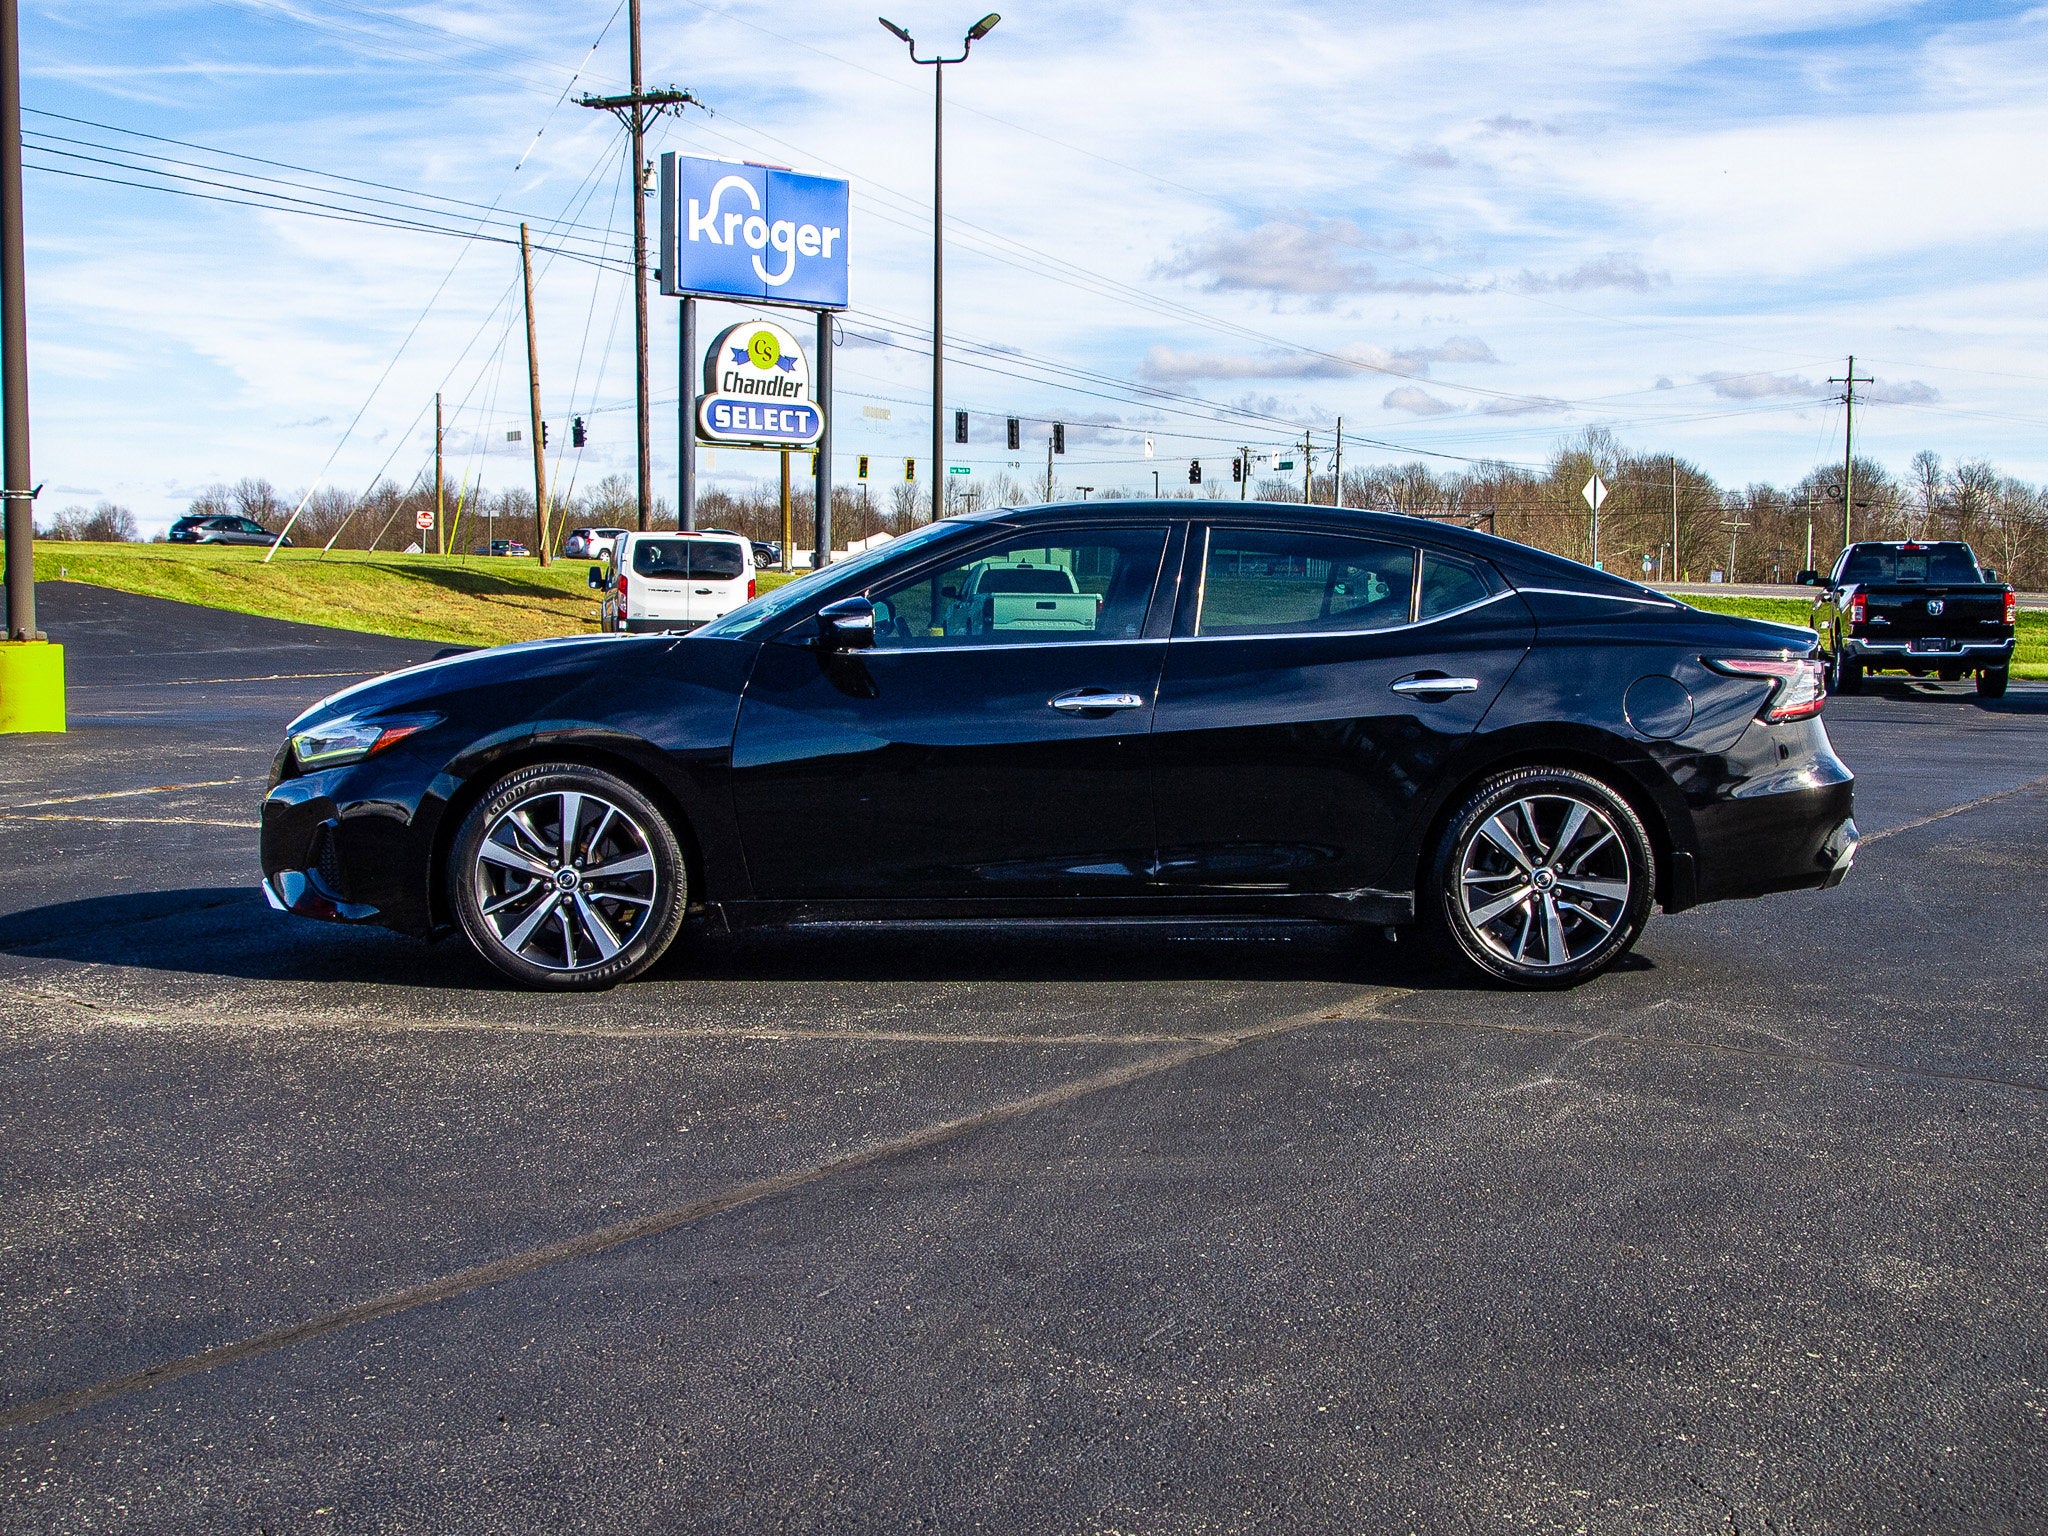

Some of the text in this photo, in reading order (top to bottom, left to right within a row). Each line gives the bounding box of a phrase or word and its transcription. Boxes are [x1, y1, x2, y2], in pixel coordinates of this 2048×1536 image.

[688, 175, 841, 286] Kroger
[754, 340, 772, 361] CS
[723, 371, 803, 398] Chandler
[715, 405, 811, 433] SELECT
